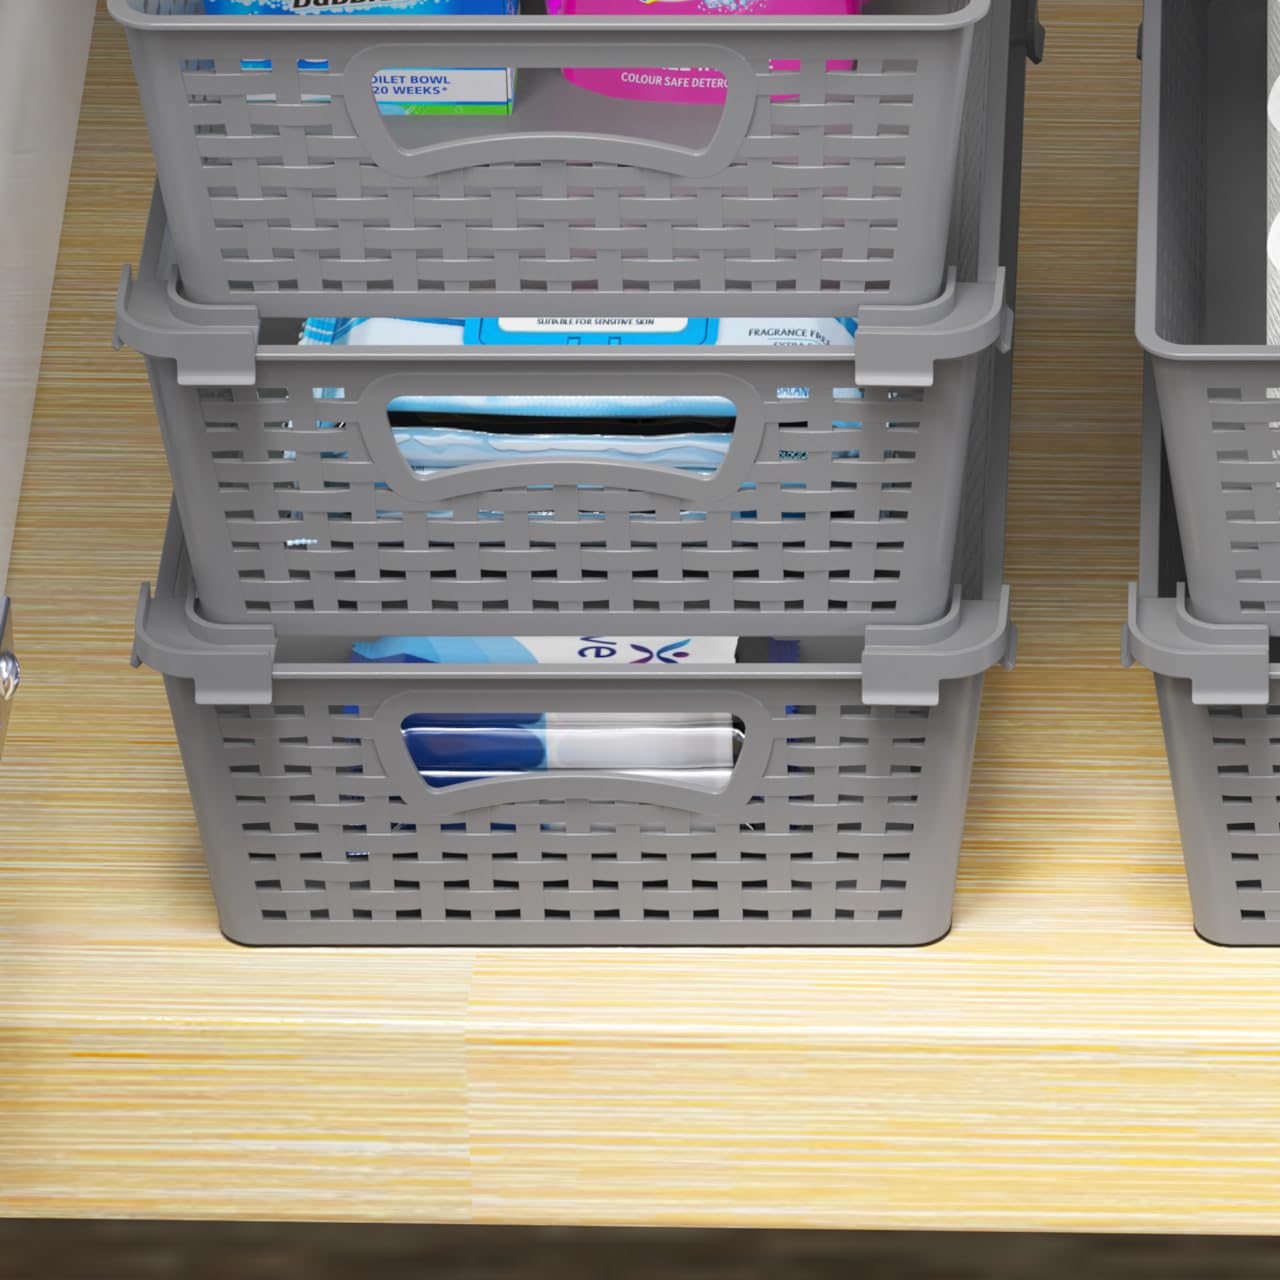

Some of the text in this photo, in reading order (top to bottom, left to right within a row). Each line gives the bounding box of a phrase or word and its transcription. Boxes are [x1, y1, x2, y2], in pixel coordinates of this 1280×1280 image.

[410, 75, 451, 85] BOWL
[621, 71, 662, 86] COLOUR
[664, 76, 690, 87] SAFE
[575, 318, 592, 326] FOR
[635, 318, 655, 326] SKIN
[748, 328, 808, 337] FRAGRANCE
